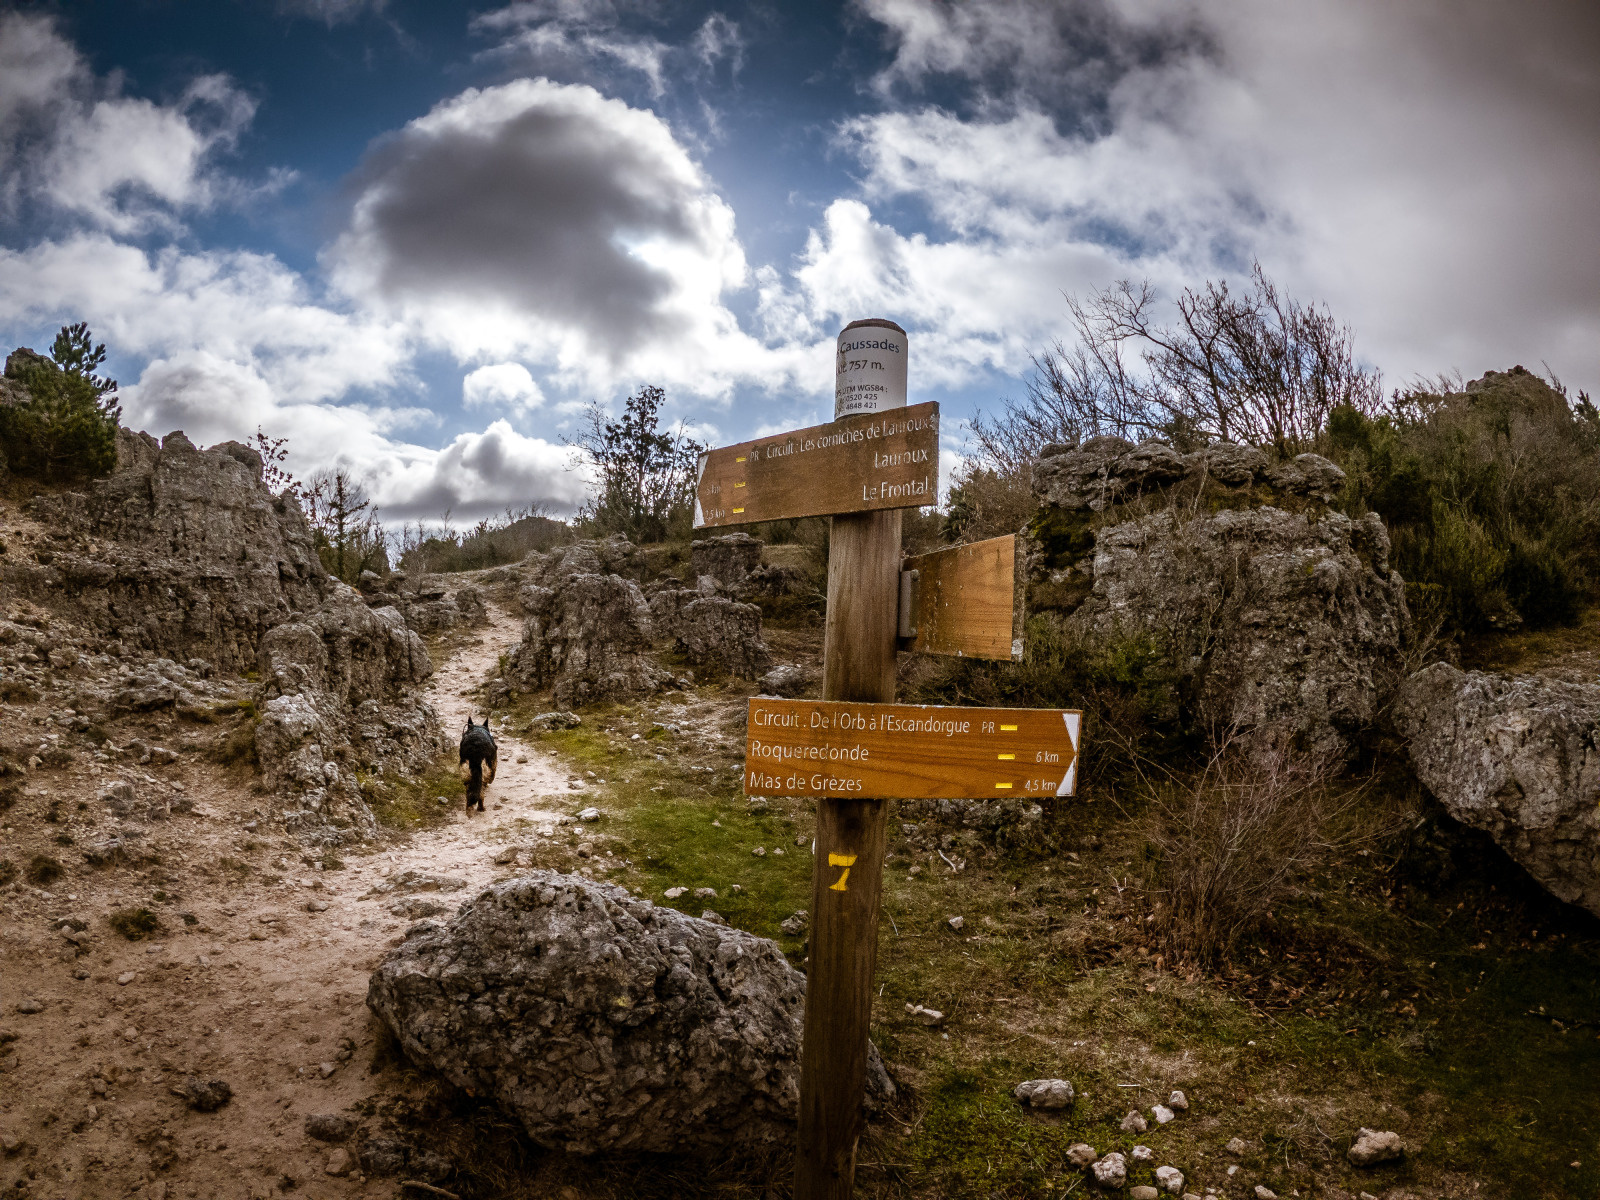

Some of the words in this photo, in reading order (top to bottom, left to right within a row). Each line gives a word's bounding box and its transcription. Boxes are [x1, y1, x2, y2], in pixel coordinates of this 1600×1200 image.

[840, 339, 900, 353] Caussades
[849, 359, 868, 371] 757
[864, 393, 878, 401] 425
[750, 450, 759, 462] PR
[800, 437, 816, 453] Les
[817, 427, 864, 449] corniches
[866, 422, 880, 440] de
[882, 418, 929, 437] Lauroux
[874, 449, 928, 469] Lauroux
[863, 484, 878, 501] Le
[881, 475, 928, 499] Frontal
[754, 708, 800, 728] Circuit
[810, 711, 830, 729] De
[833, 711, 866, 731] l'Orb
[869, 714, 877, 731] à
[880, 713, 970, 737] l'Escandorgue
[981, 721, 995, 734] PR
[751, 740, 869, 763] Roqueredonde
[1036, 751, 1042, 763] 6
[1044, 751, 1059, 763] km
[750, 771, 782, 790] Mas
[786, 772, 806, 790] de
[811, 773, 863, 792] Grèzes
[1024, 779, 1039, 793] 4,5
[1041, 779, 1057, 792] km
